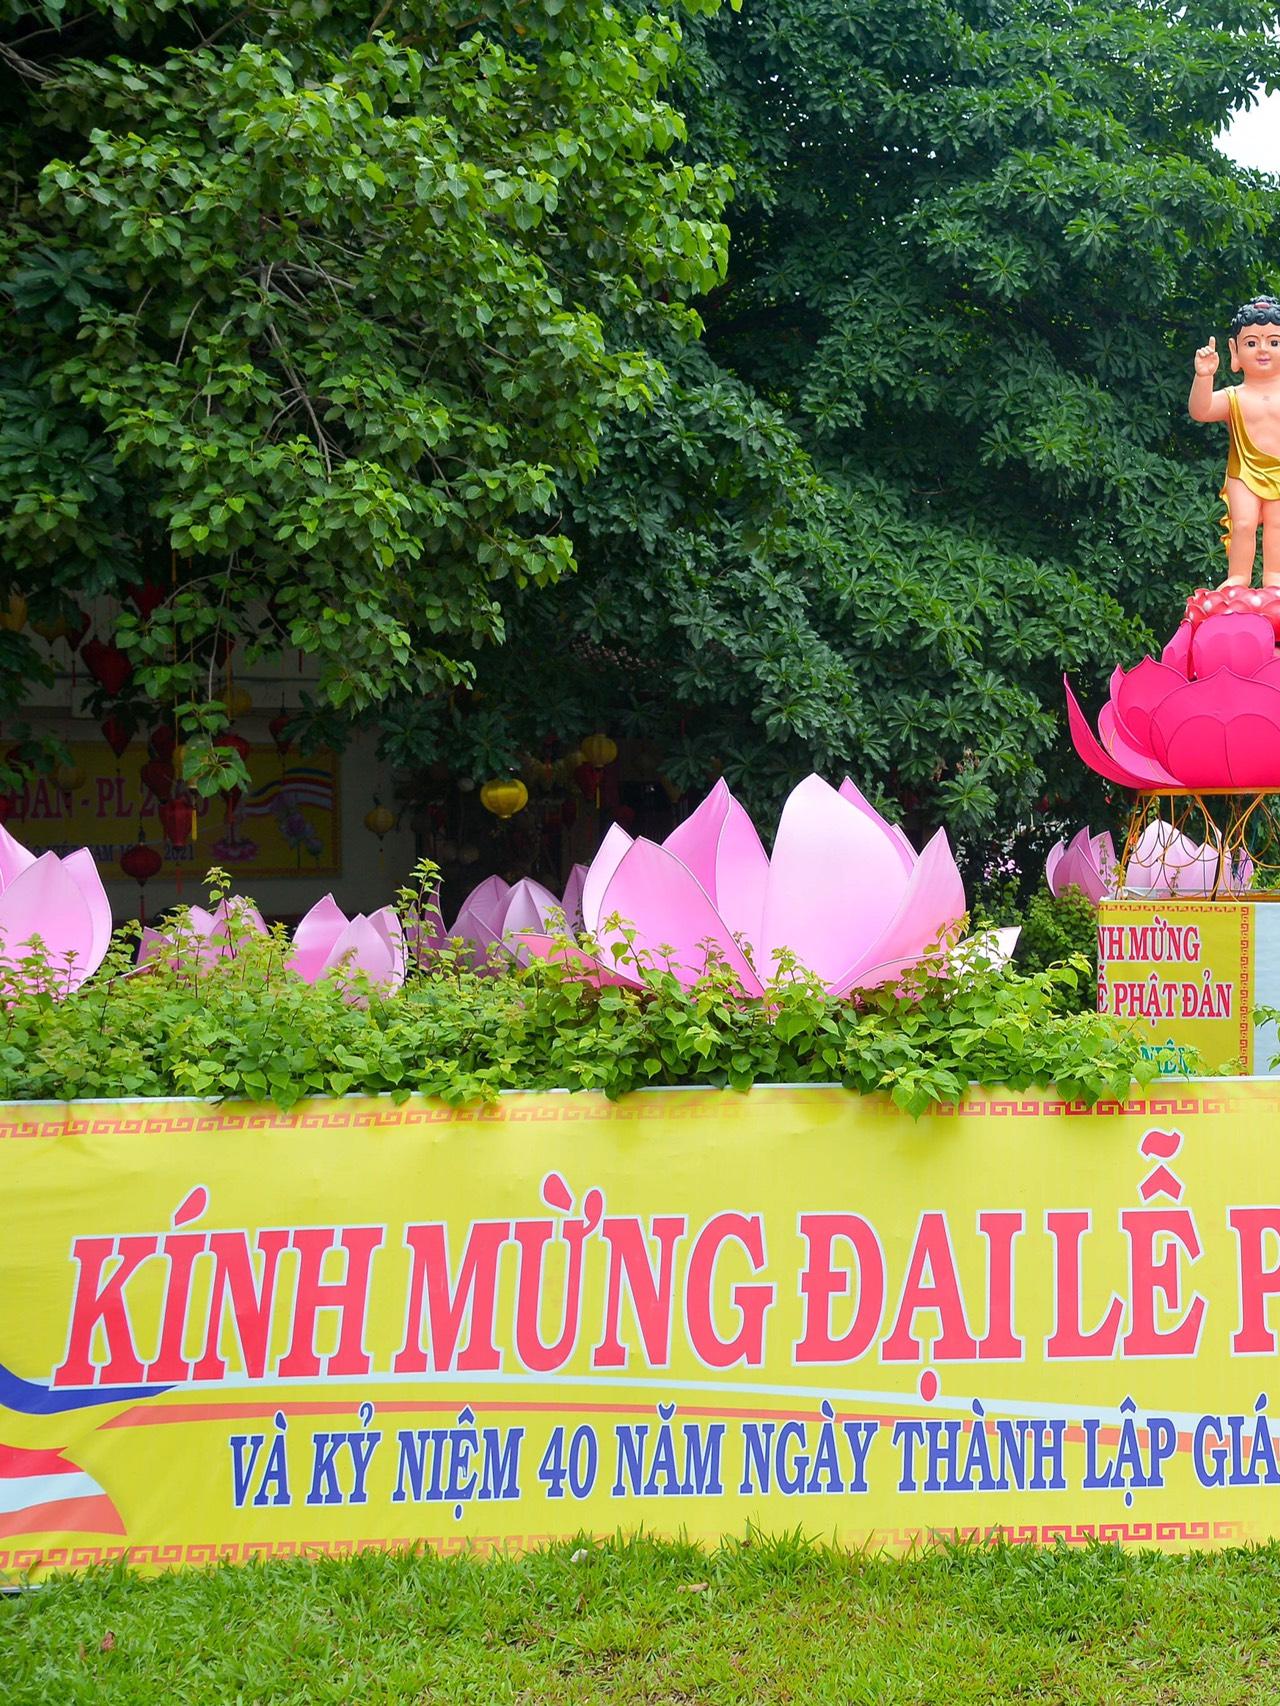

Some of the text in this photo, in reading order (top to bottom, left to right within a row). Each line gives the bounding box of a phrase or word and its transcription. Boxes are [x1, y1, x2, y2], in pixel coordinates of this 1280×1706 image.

[95, 776, 133, 818] PL
[1128, 915, 1200, 962] MỪNG
[1113, 972, 1178, 1026] PHẬT
[1181, 969, 1232, 1018] ĐẢN
[54, 1186, 383, 1388] KÍNH
[393, 1173, 774, 1374] MỪNG
[795, 1212, 1024, 1402] ĐẠI
[1047, 1130, 1206, 1359] LỄ
[229, 1411, 292, 1508] VÀ
[305, 1401, 382, 1506] KỶ
[391, 1405, 525, 1519] NIỆM
[537, 1424, 598, 1500] 40
[611, 1402, 726, 1497] NĂM
[738, 1398, 879, 1496] NGÀY
[891, 1397, 1067, 1493] THÀNH
[1082, 1395, 1178, 1507] LẬP
